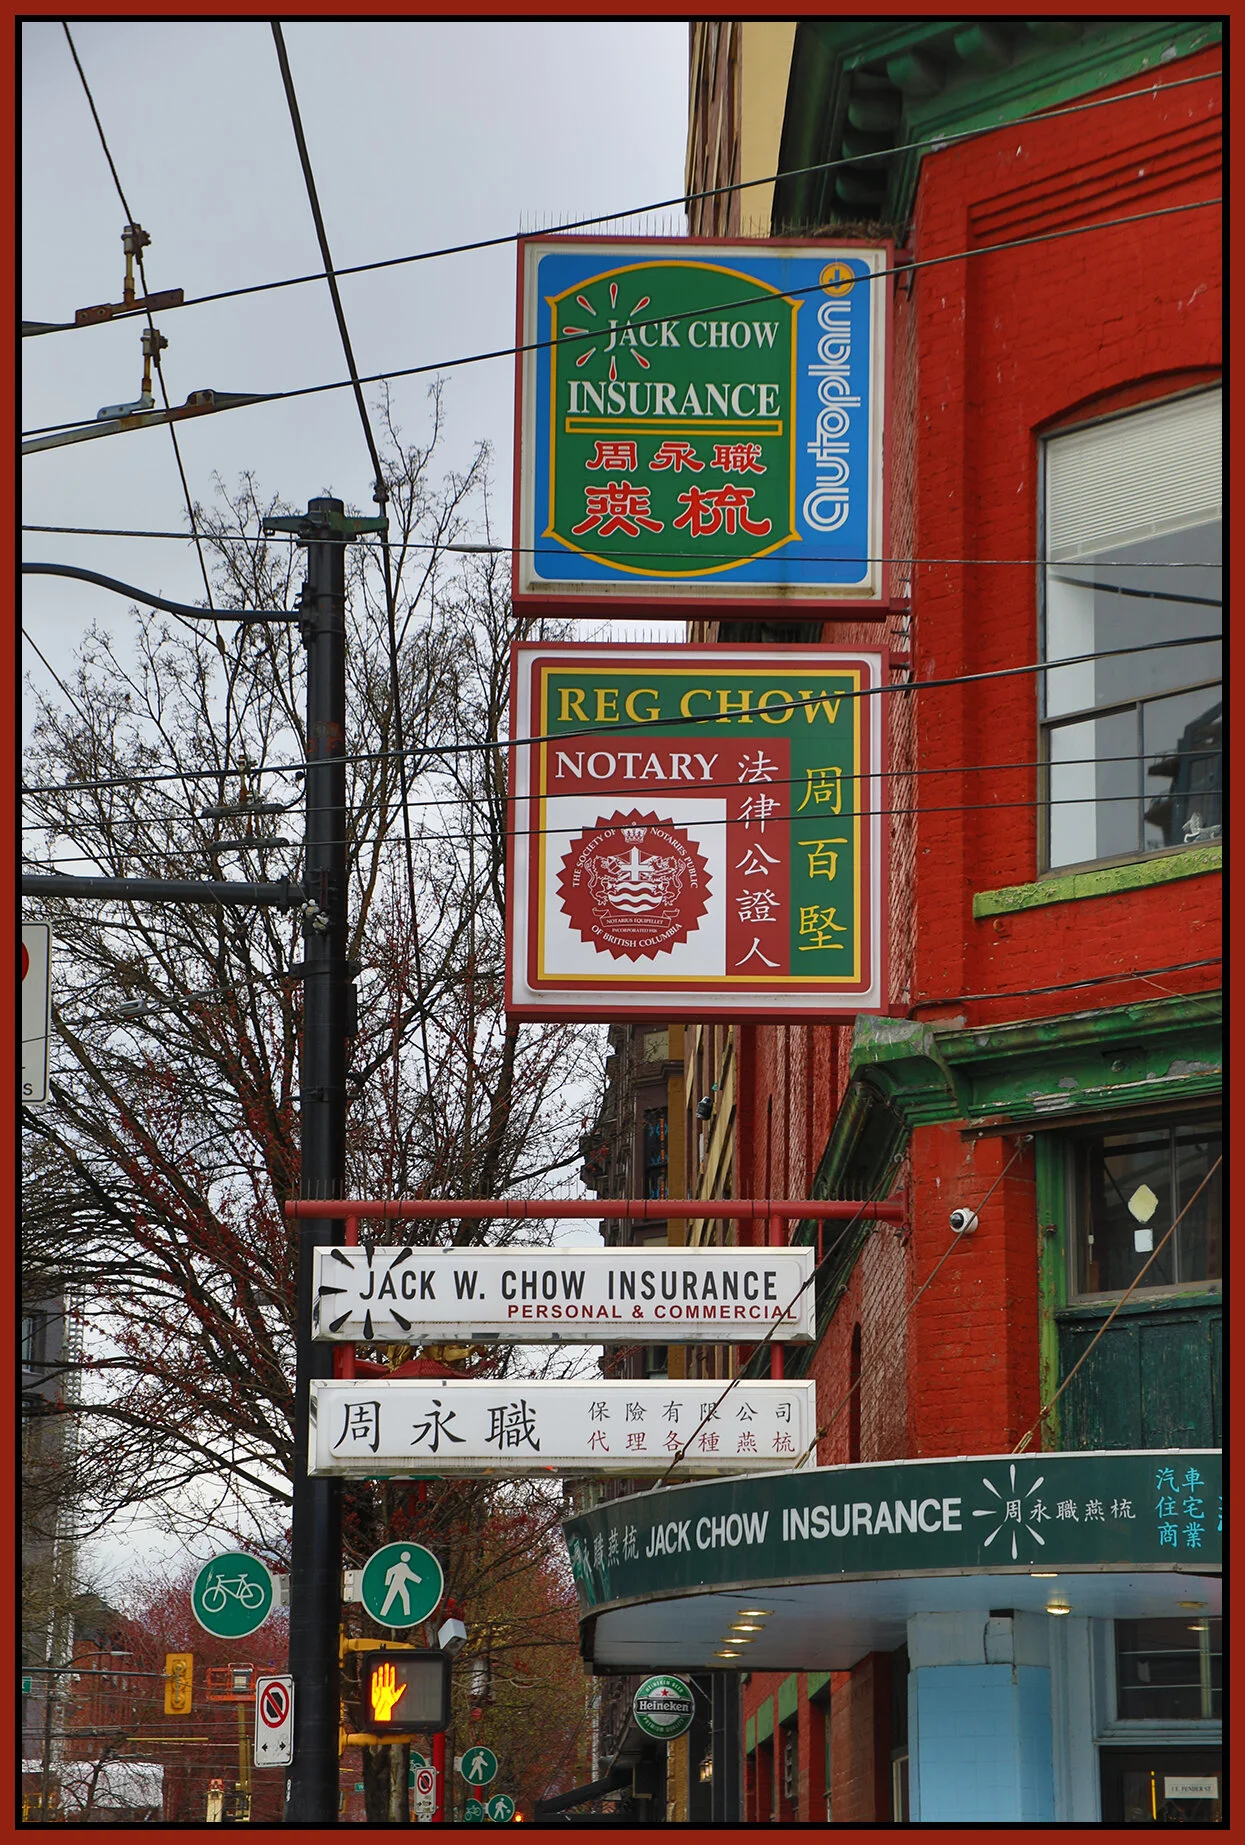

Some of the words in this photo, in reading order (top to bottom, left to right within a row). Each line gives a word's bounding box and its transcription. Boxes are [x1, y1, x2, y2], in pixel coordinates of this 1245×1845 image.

[604, 319, 680, 352] JACK
[688, 320, 779, 349] CHOW
[567, 380, 780, 417] INSURANCE
[802, 300, 861, 532] autoplan
[585, 441, 767, 474] 周永職
[571, 481, 772, 537] 燕梳
[557, 688, 661, 723] REG
[680, 689, 847, 725] CHOW
[555, 751, 719, 781] NOTARY
[573, 869, 581, 888] THE
[577, 835, 604, 867] SOCIETY
[650, 827, 687, 857] NOTARIES
[685, 856, 698, 889] PUBLIC
[735, 750, 781, 967] 法律公證人
[797, 766, 848, 951] 周百堅
[591, 924, 603, 935] OF
[602, 932, 637, 948] BRITISH
[639, 923, 683, 948] COLUMBIA
[359, 1269, 436, 1300] JACK
[453, 1270, 485, 1300] W.
[500, 1270, 586, 1300] CHOW
[607, 1270, 778, 1300] INSURANCE
[508, 1304, 622, 1319] PERSONAL
[632, 1304, 645, 1319] &
[654, 1304, 798, 1319] COMMERCIAL
[333, 1399, 540, 1453] 周永職
[588, 1400, 792, 1423] 保險有限公司
[587, 1430, 796, 1453] 代理各種燕梳
[1155, 1467, 1205, 1493] 汽車
[1003, 1498, 1136, 1523] 周永職燕梳
[1155, 1495, 1205, 1520] 住宅
[646, 1519, 692, 1558] JACK
[696, 1510, 768, 1550] CHOW
[782, 1498, 963, 1542] INSURANCE
[1157, 1521, 1206, 1549] 商業
[639, 1700, 689, 1712] Heineken
